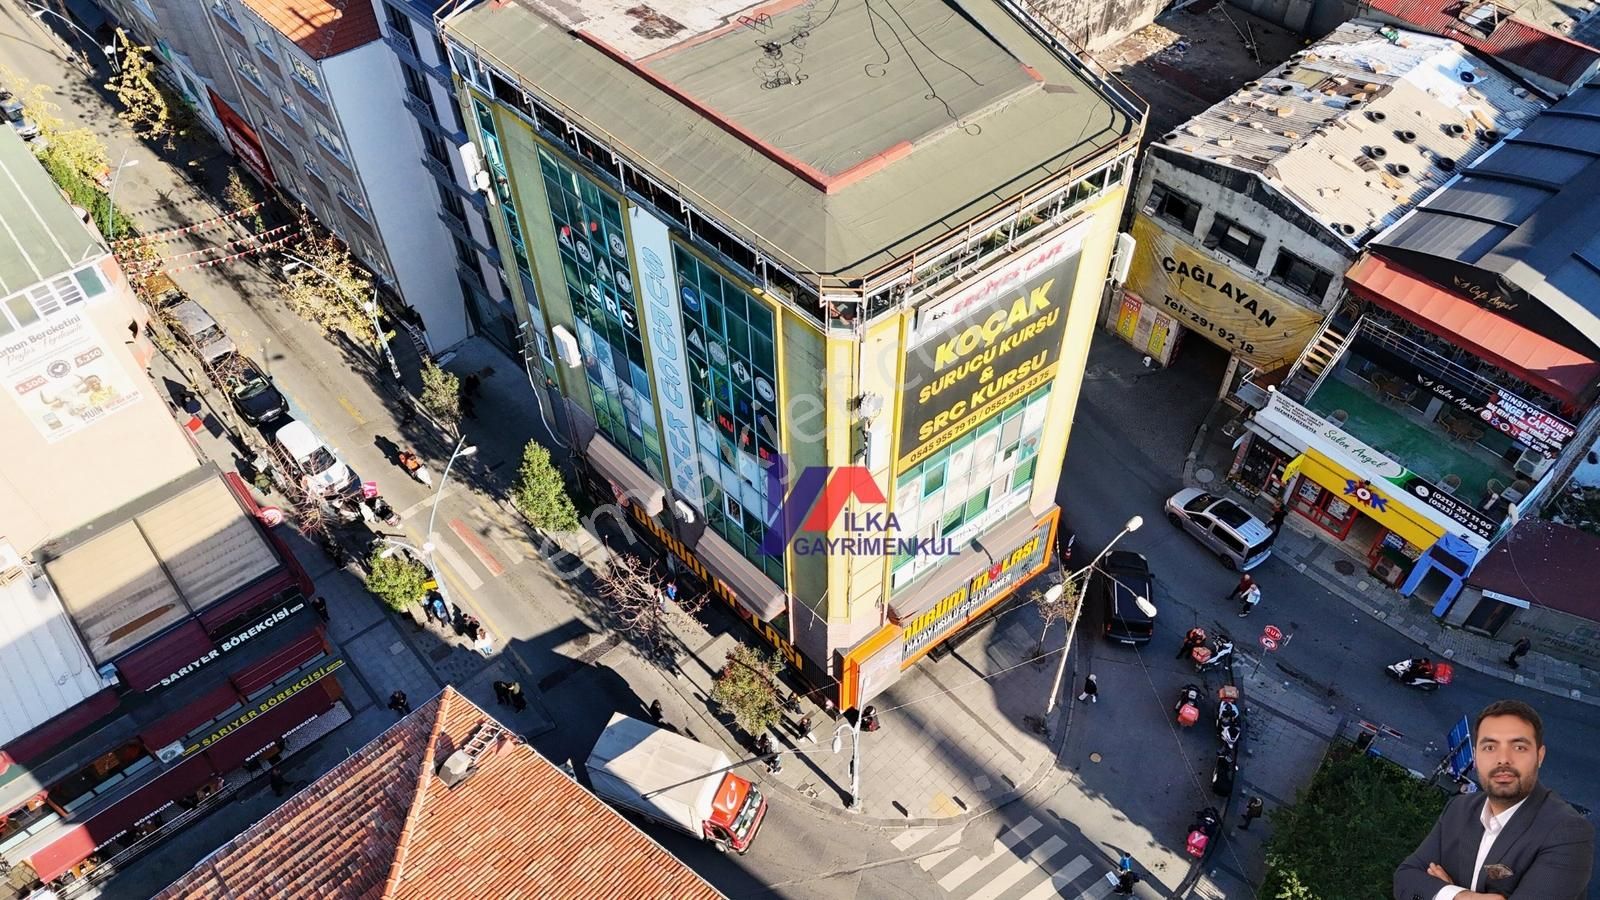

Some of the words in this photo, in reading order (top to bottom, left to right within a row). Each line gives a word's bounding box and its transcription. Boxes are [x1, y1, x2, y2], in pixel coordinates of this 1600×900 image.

[589, 283, 634, 328] SRC
[1163, 294, 1188, 315] Tel:
[1488, 296, 1518, 310] Angel
[28, 314, 81, 343] Bereketini
[934, 278, 1055, 373] KOÇAK
[998, 307, 1060, 356] KURSU
[918, 400, 967, 441] SRC
[970, 349, 1048, 409] KURSU
[979, 366, 994, 384] &
[910, 440, 934, 463] 0545
[935, 429, 953, 446] 955
[954, 422, 966, 434] 79
[967, 415, 977, 426] 19
[984, 396, 1007, 415] 0552
[1008, 383, 1026, 400] 949
[1026, 376, 1038, 389] 33
[1039, 370, 1049, 382] 75
[1454, 397, 1484, 413] Angel
[1496, 399, 1527, 420] ANGEL
[1527, 416, 1566, 442] CAFE'DE
[1497, 389, 1546, 420] BEINSPORT
[1544, 416, 1575, 438] BURDA
[1323, 429, 1350, 450] Salon
[1351, 448, 1388, 468] Angel
[1428, 497, 1453, 516] (0533)
[1453, 511, 1467, 524] 927
[1467, 521, 1478, 531] 29
[1478, 528, 1489, 538] 92
[1432, 491, 1456, 509] (0212)
[1456, 504, 1471, 517] 291
[1471, 513, 1481, 524] 11
[1480, 518, 1492, 530] 00
[160, 649, 220, 687] SARIYER
[221, 607, 290, 652] BÖREKÇİSİ
[1266, 628, 1280, 638] DUR
[202, 710, 258, 747] SARIYER
[259, 667, 326, 712] BÖREKÇİSİ
[245, 741, 276, 762] SARIYER
